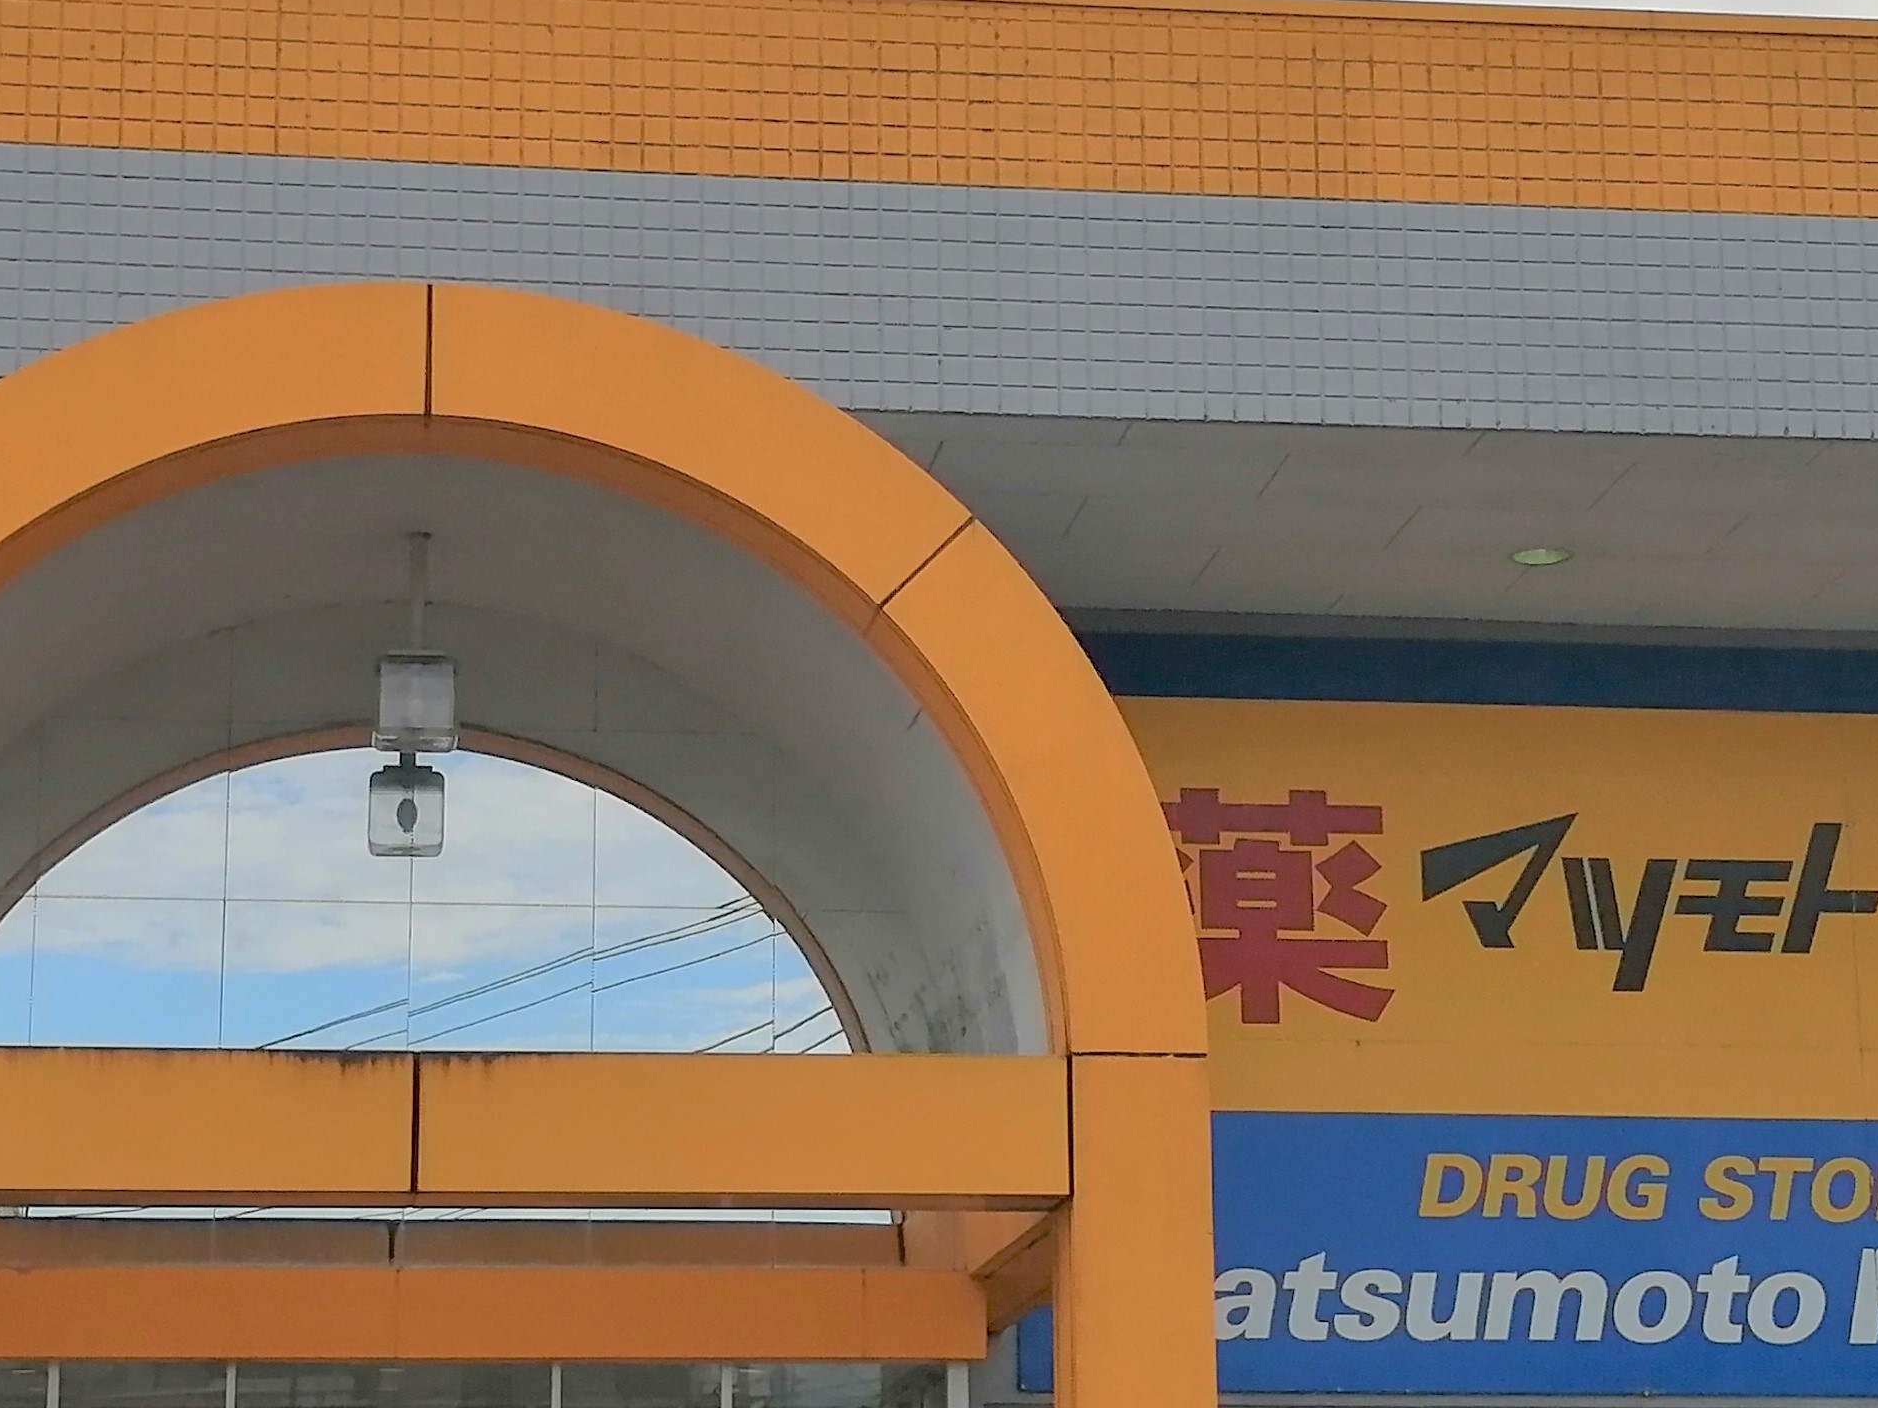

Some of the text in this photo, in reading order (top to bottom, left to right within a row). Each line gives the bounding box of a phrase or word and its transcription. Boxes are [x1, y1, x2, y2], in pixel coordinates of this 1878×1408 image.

[1161, 788, 1395, 1024] 薬
[1418, 1153, 1669, 1222] DRUG
[1213, 1250, 1827, 1348] atsumoto
